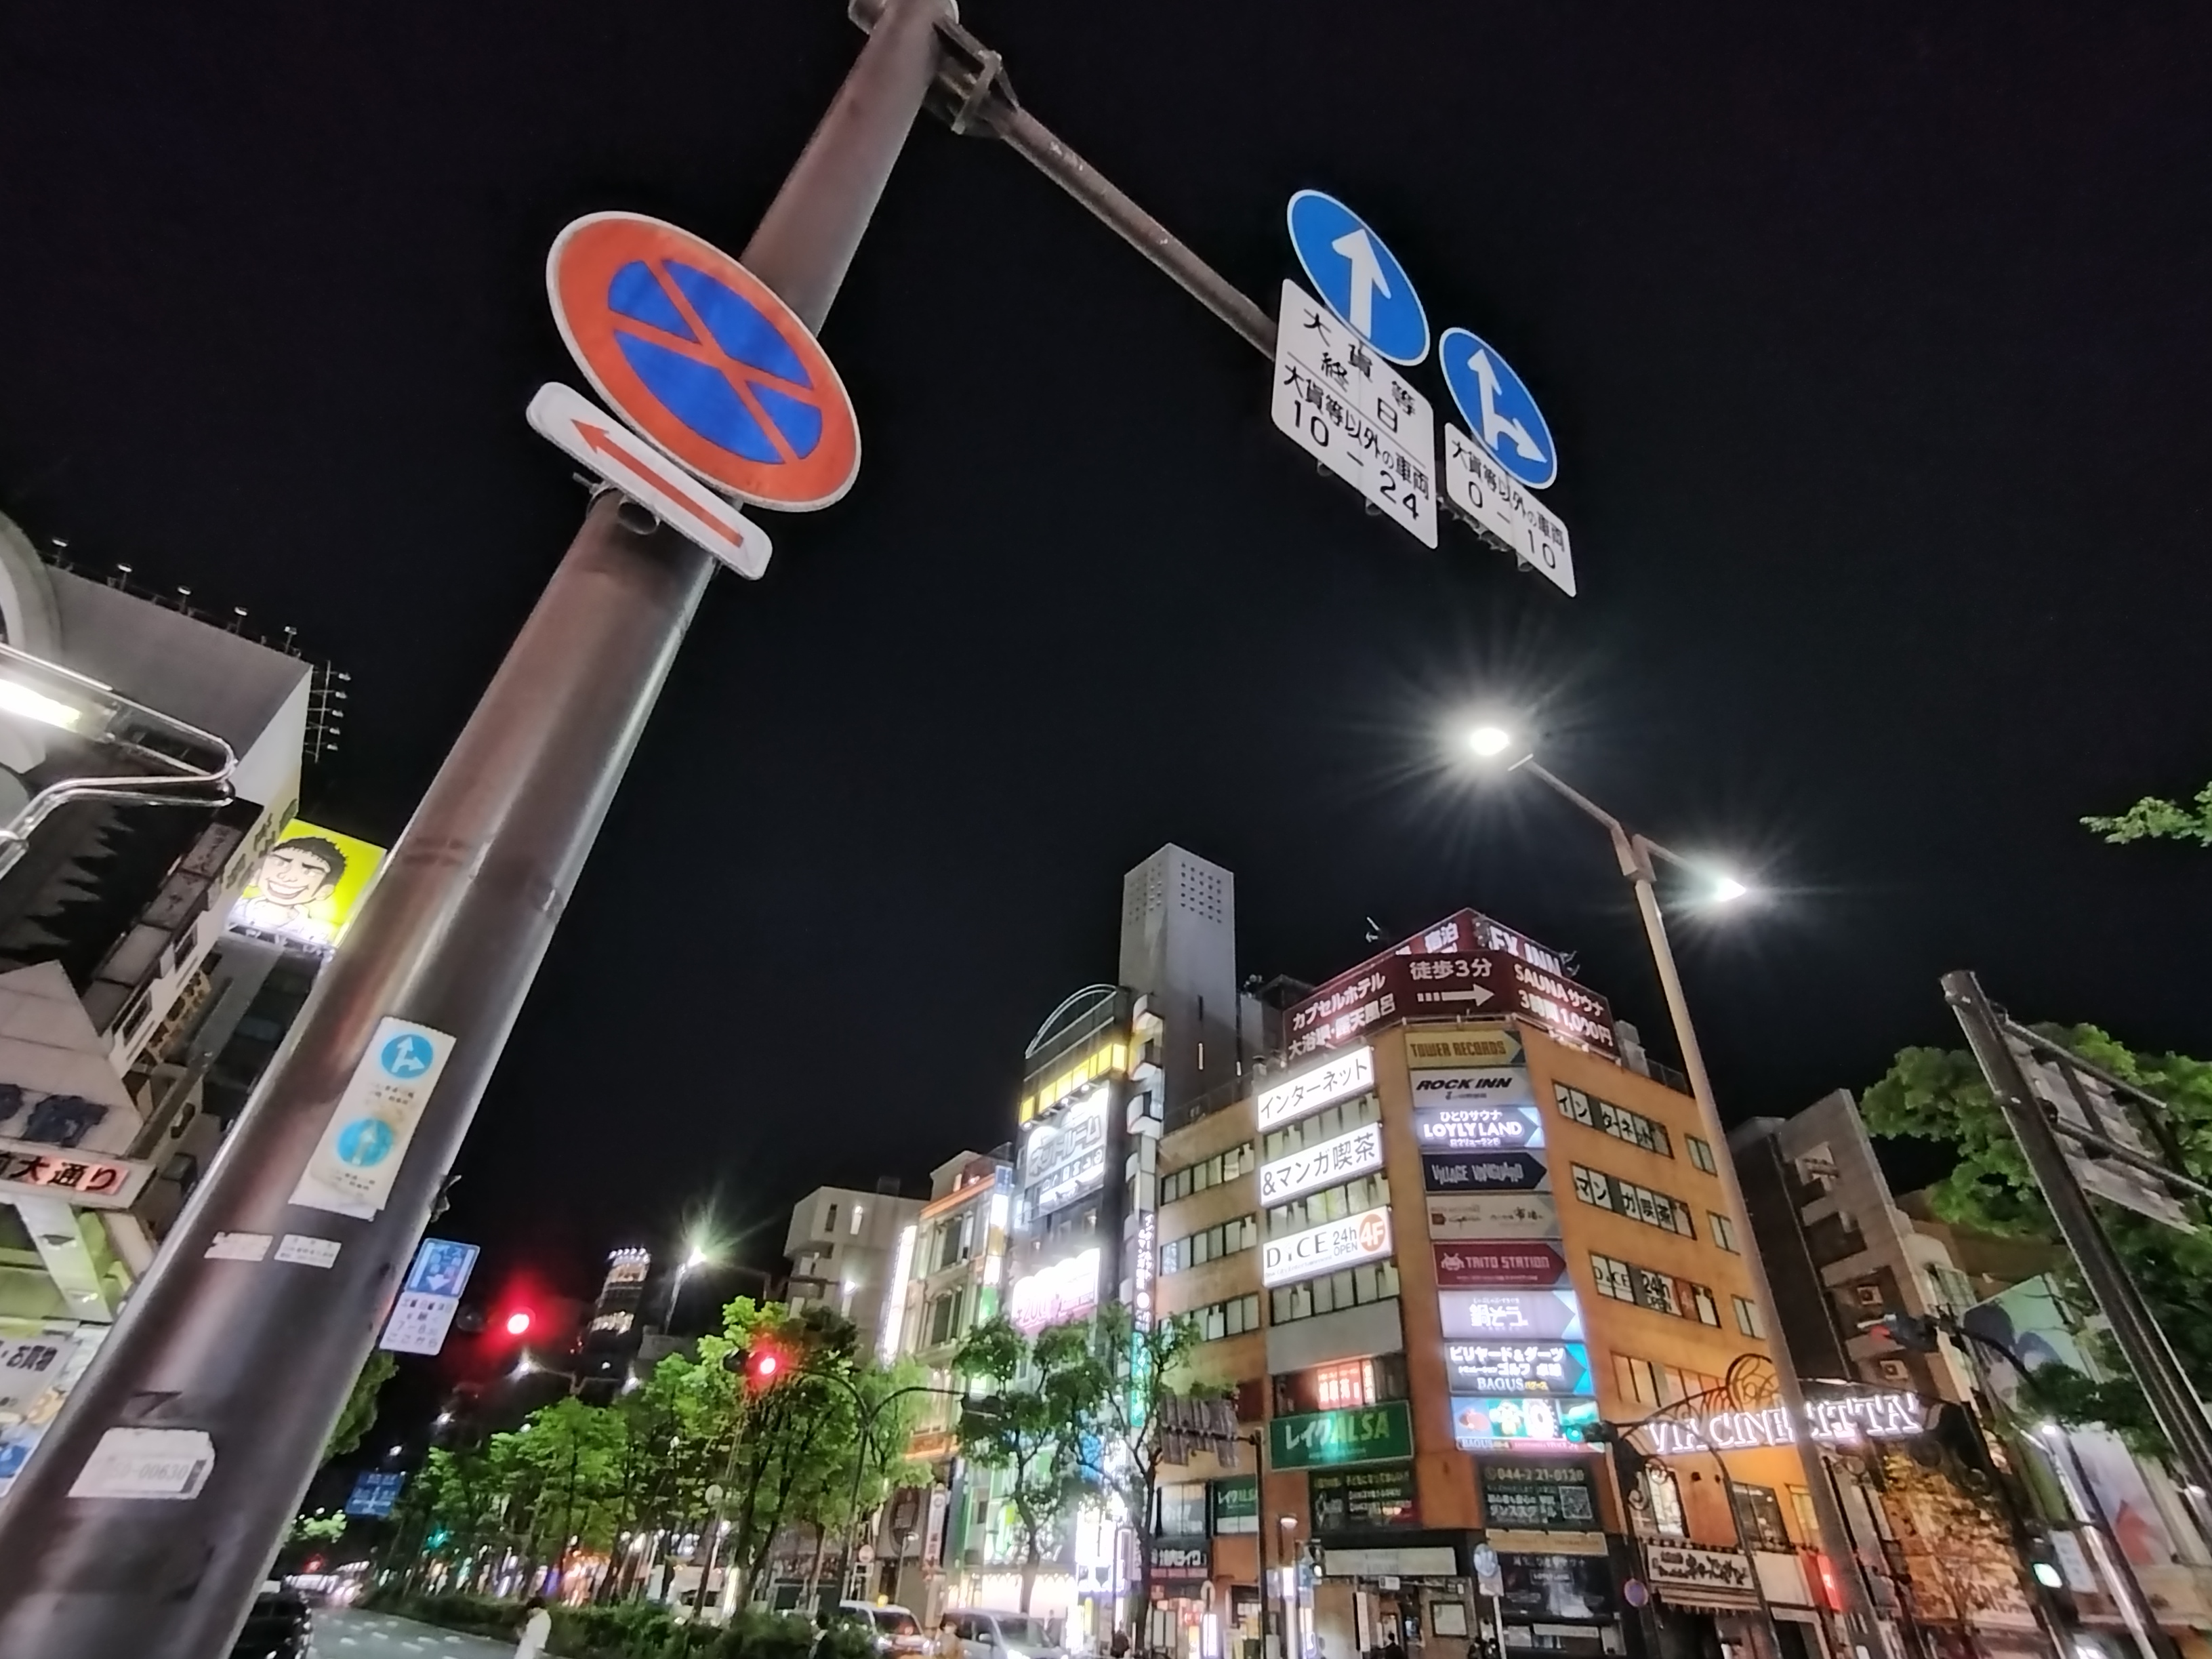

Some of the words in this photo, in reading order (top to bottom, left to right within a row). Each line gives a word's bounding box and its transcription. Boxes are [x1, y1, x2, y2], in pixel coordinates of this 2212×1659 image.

[1303, 308, 1416, 417] 大貨等
[1321, 352, 1398, 434] 終日
[1283, 364, 1429, 500] 大貨等以外の車両
[1452, 439, 1565, 553] 大貨等以外の車両
[1410, 958, 1492, 981] 徒歩3分
[1523, 942, 1562, 977] INN
[1292, 972, 1386, 1031] カプセルホテル
[1410, 1042, 1452, 1058] TOWER
[1452, 1040, 1507, 1056] RECORDS
[1261, 1057, 1368, 1119] インターネット
[1416, 1078, 1475, 1090] ROCK
[1475, 1078, 1513, 1089] INN
[1440, 1110, 1503, 1123] ひとりサウナ
[1423, 1123, 1478, 1139] LOYLY
[1479, 1122, 1524, 1137] LAND
[1262, 1132, 1376, 1197] &マンガ喫茶
[1431, 1164, 1469, 1185] VILLAGE
[1471, 1162, 1524, 1183] VANGUARD
[1332, 1226, 1357, 1246] 24h
[1359, 1221, 1384, 1247] 4F
[1333, 1241, 1358, 1256] OPEN
[1465, 1256, 1498, 1269] TAITO
[1500, 1256, 1550, 1269] STATION
[1450, 1345, 1564, 1362] ビリヤード&ダーツ
